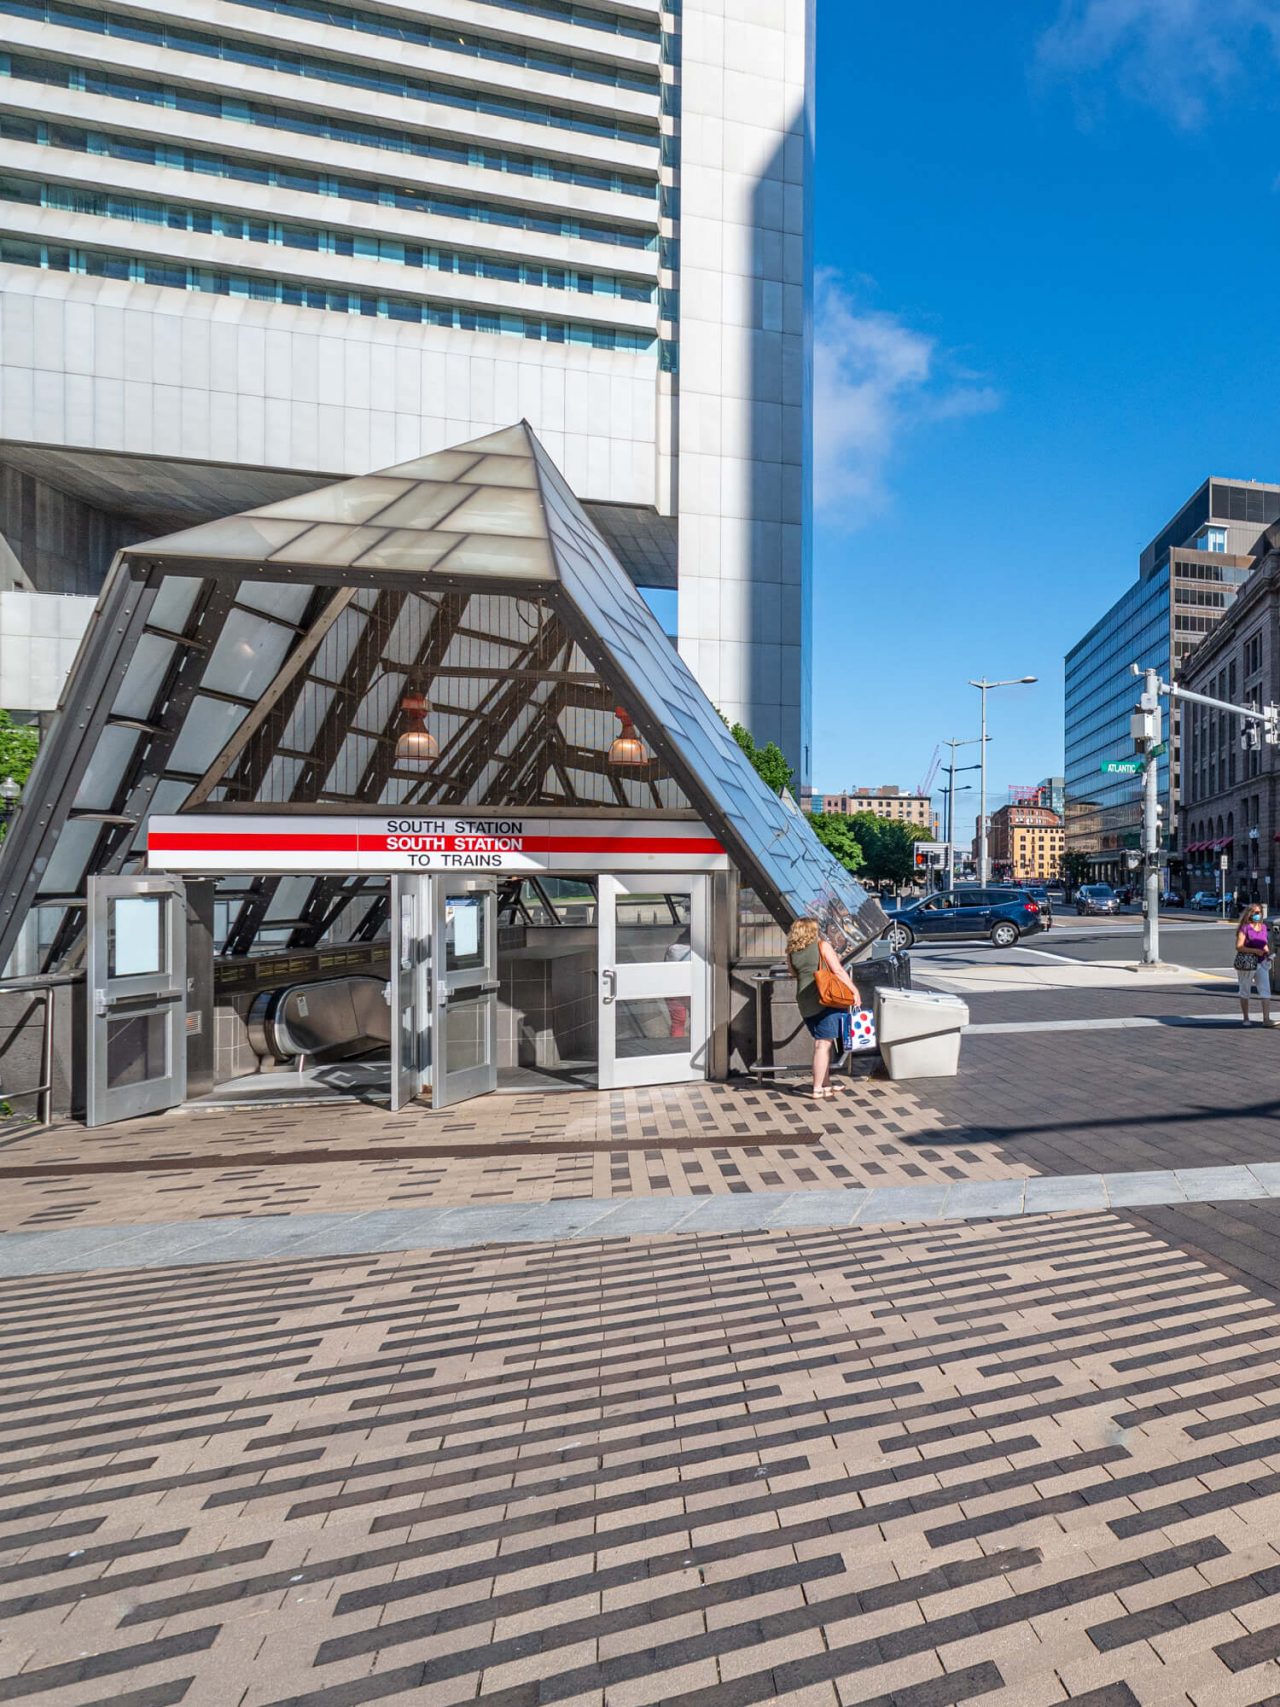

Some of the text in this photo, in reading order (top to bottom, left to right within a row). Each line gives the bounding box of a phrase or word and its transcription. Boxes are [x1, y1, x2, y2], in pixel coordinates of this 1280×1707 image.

[1107, 763, 1136, 773] ATLANTIC
[387, 820, 522, 834] SOUTH STATION
[386, 836, 522, 851] SOUTH STATION
[407, 854, 502, 866] TO TRAINS
